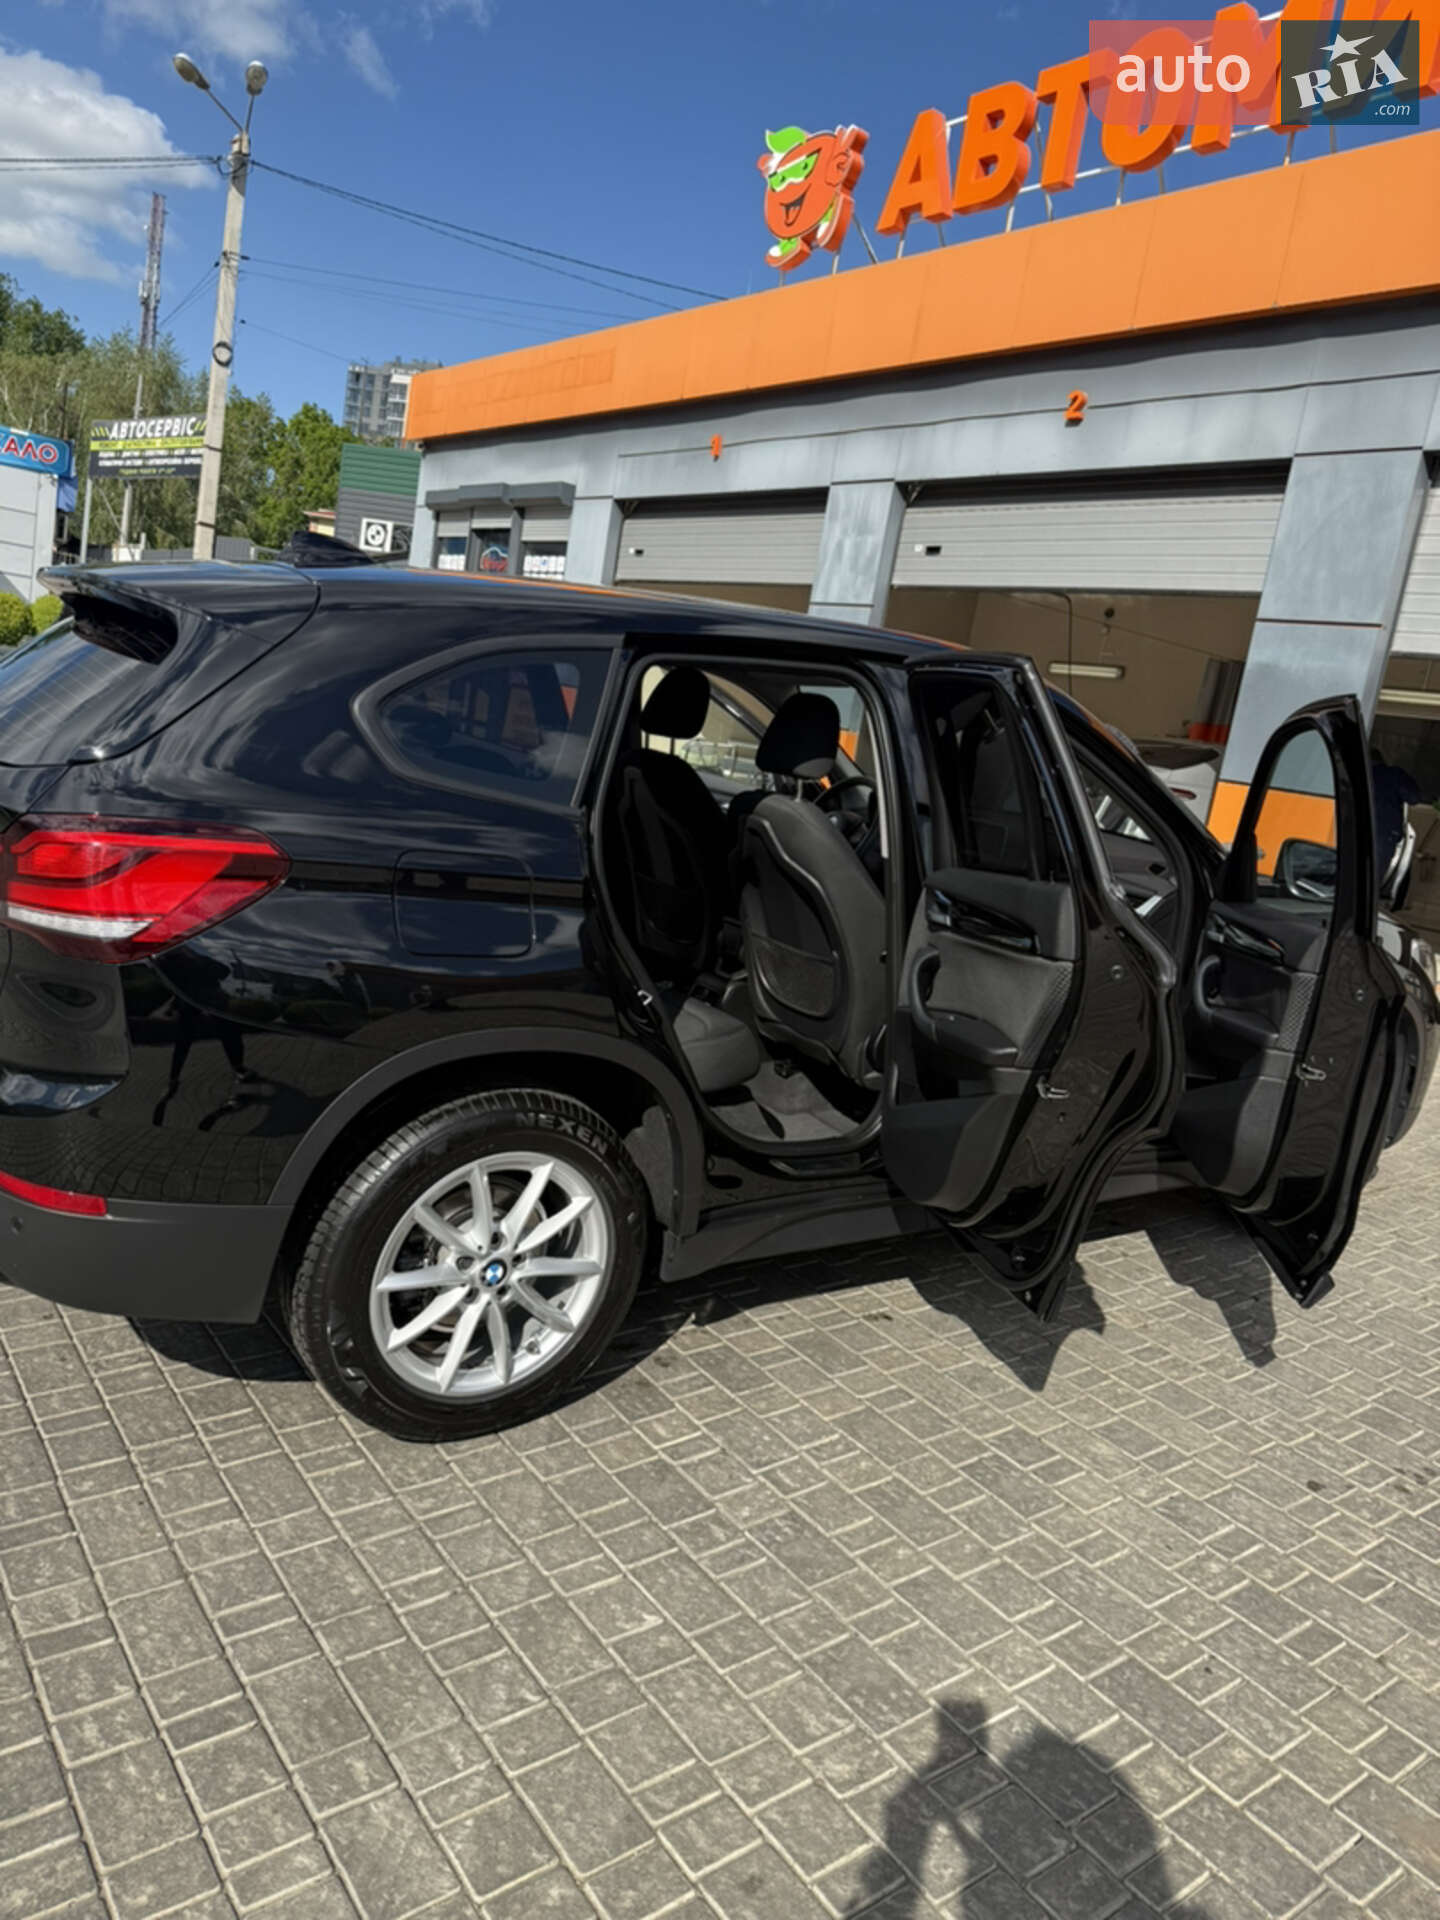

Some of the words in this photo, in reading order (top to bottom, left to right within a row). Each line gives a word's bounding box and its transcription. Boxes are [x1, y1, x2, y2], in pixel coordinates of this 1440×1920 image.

[1065, 390, 1088, 424] 2
[109, 417, 197, 440] АВТОСЕРВІС
[0, 435, 59, 464] АЛО
[710, 434, 722, 459] 1
[515, 1111, 608, 1156] NEXEN
